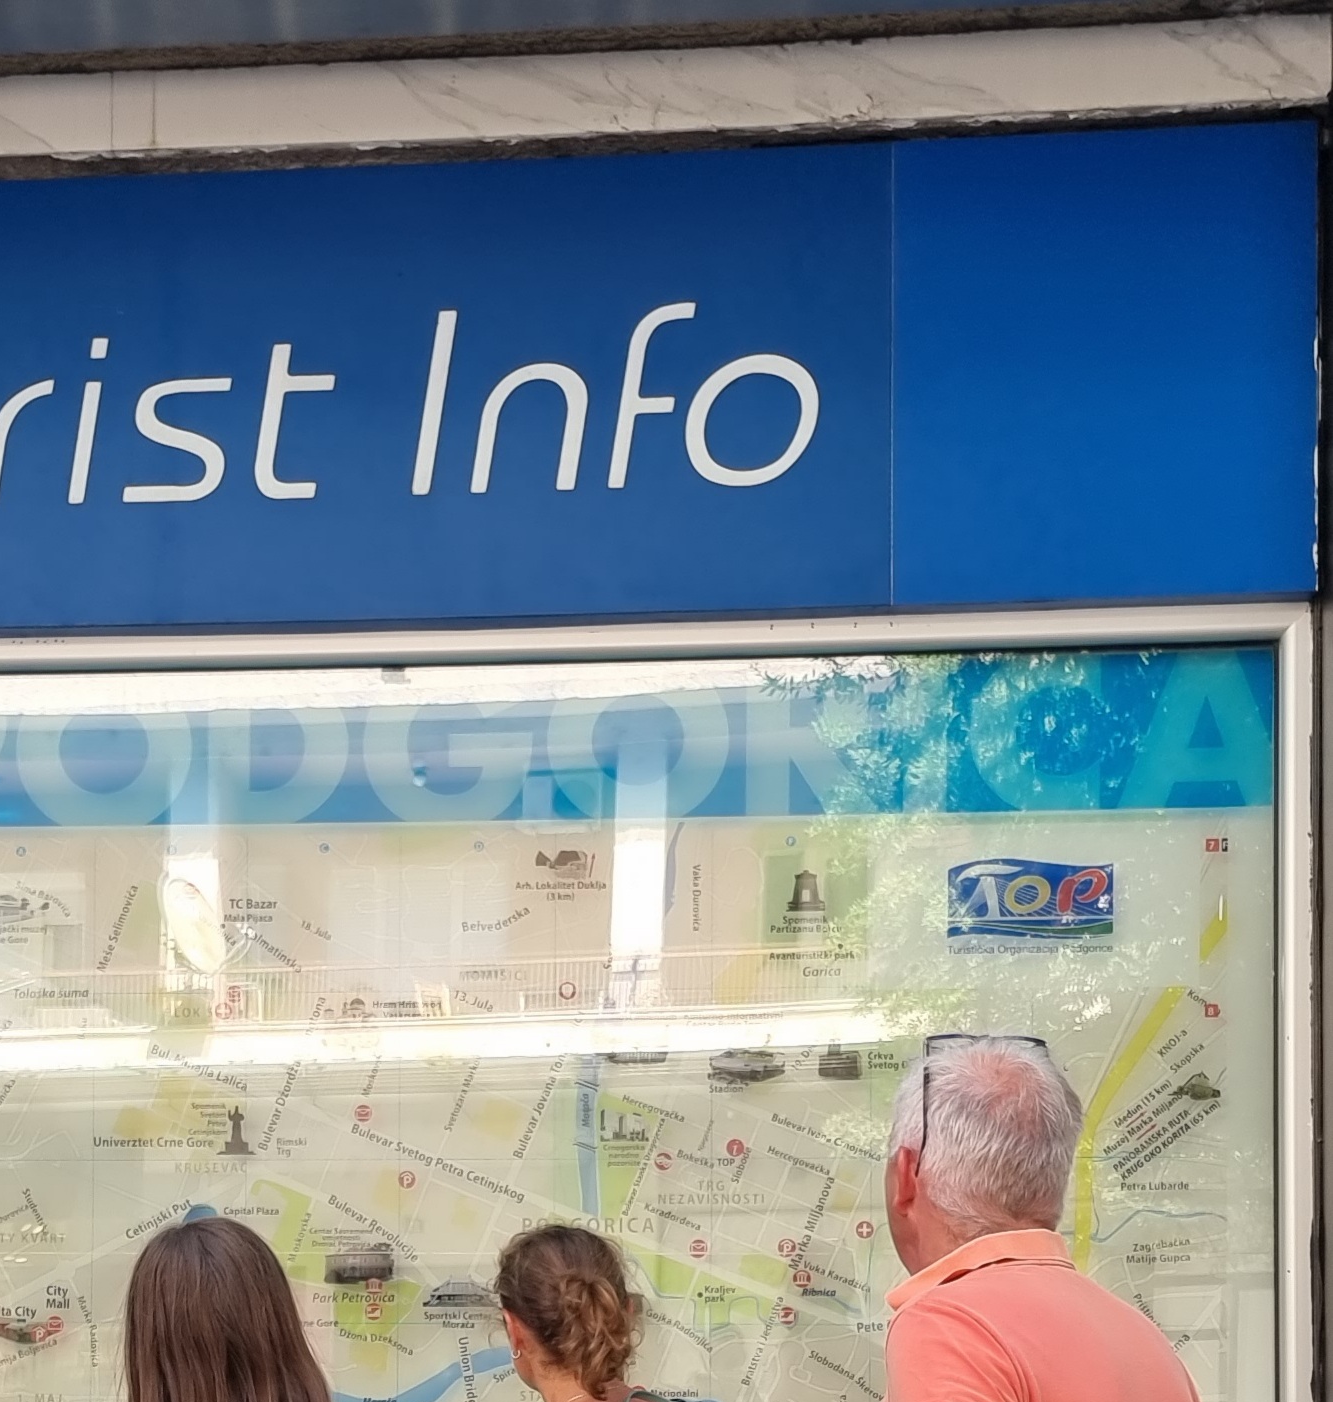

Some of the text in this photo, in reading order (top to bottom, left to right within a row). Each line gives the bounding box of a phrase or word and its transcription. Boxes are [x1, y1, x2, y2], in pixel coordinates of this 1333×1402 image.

[412, 302, 818, 494] Info
[536, 881, 576, 891] Lokalitet
[229, 899, 278, 910] TC Bazar
[224, 914, 273, 924] Mala Pijaca
[461, 907, 531, 933] Belvederska
[783, 916, 828, 925] Spomenik
[770, 924, 814, 933] Partizanu
[8, 935, 29, 944] Gore
[834, 951, 855, 961] park
[947, 943, 1059, 957] Turistička Organizacija
[802, 966, 841, 978] Gorica
[57, 989, 89, 999] šuma
[454, 990, 495, 1013] 13. Jula
[1157, 1029, 1188, 1061] KNOJ-a
[867, 1051, 900, 1072] Crkva Svetog
[1170, 1043, 1205, 1074] Skopska
[216, 1070, 248, 1092] Lalića
[621, 1094, 685, 1124] Hercegovačka
[1115, 1103, 1143, 1128] Medun
[1153, 1080, 1173, 1102] km)
[258, 1107, 285, 1152] Bulevar
[770, 1112, 808, 1134] Bulevar
[93, 1136, 214, 1149] Univerztet Crne Gore
[276, 1137, 307, 1147] Rimski
[513, 1114, 540, 1160] Bulevar
[1103, 1116, 1154, 1156] Muzej Marka
[1120, 1159, 1144, 1182] KRUG
[1143, 1142, 1162, 1164] OKO
[1161, 1123, 1191, 1148] KORITA
[1204, 1101, 1221, 1118] km)
[276, 1147, 291, 1158] Trg
[677, 1149, 714, 1169] Bokeška
[351, 1123, 526, 1204] Bulevar Svetog Petra Cetinjskog
[717, 1157, 735, 1167] TOP
[731, 1146, 753, 1185] Slobode
[766, 1145, 831, 1176] Hercegovačka
[698, 1180, 725, 1191] TRG
[1120, 1182, 1189, 1191] Petra Lubarde
[657, 1193, 765, 1205] NEZAVISNOSTI
[223, 1206, 279, 1217] Capital Plaza
[125, 1198, 193, 1240] Cetinjski Put
[787, 1176, 835, 1271] Marka Miljanova
[327, 1194, 418, 1263] Bulevar Revolucije
[287, 1212, 313, 1264] Moskovska
[1126, 1254, 1191, 1264] Matije Gupca
[803, 1260, 871, 1293] Vuka Karadžića
[46, 1286, 68, 1298] City
[704, 1285, 736, 1295] Kraljev
[312, 1292, 395, 1303] Park Petrovića
[704, 1294, 726, 1303] park
[46, 1299, 70, 1310] Mall
[14, 1305, 37, 1319] City
[424, 1311, 461, 1320] Sportski
[316, 1319, 339, 1327] Gore
[442, 1321, 475, 1329] Morača
[857, 1322, 883, 1333] Pete
[339, 1329, 368, 1342] Džona
[741, 1296, 784, 1388] Bratstva Jedinstva
[458, 1336, 471, 1372] Union
[808, 1350, 855, 1382] Slobodana
